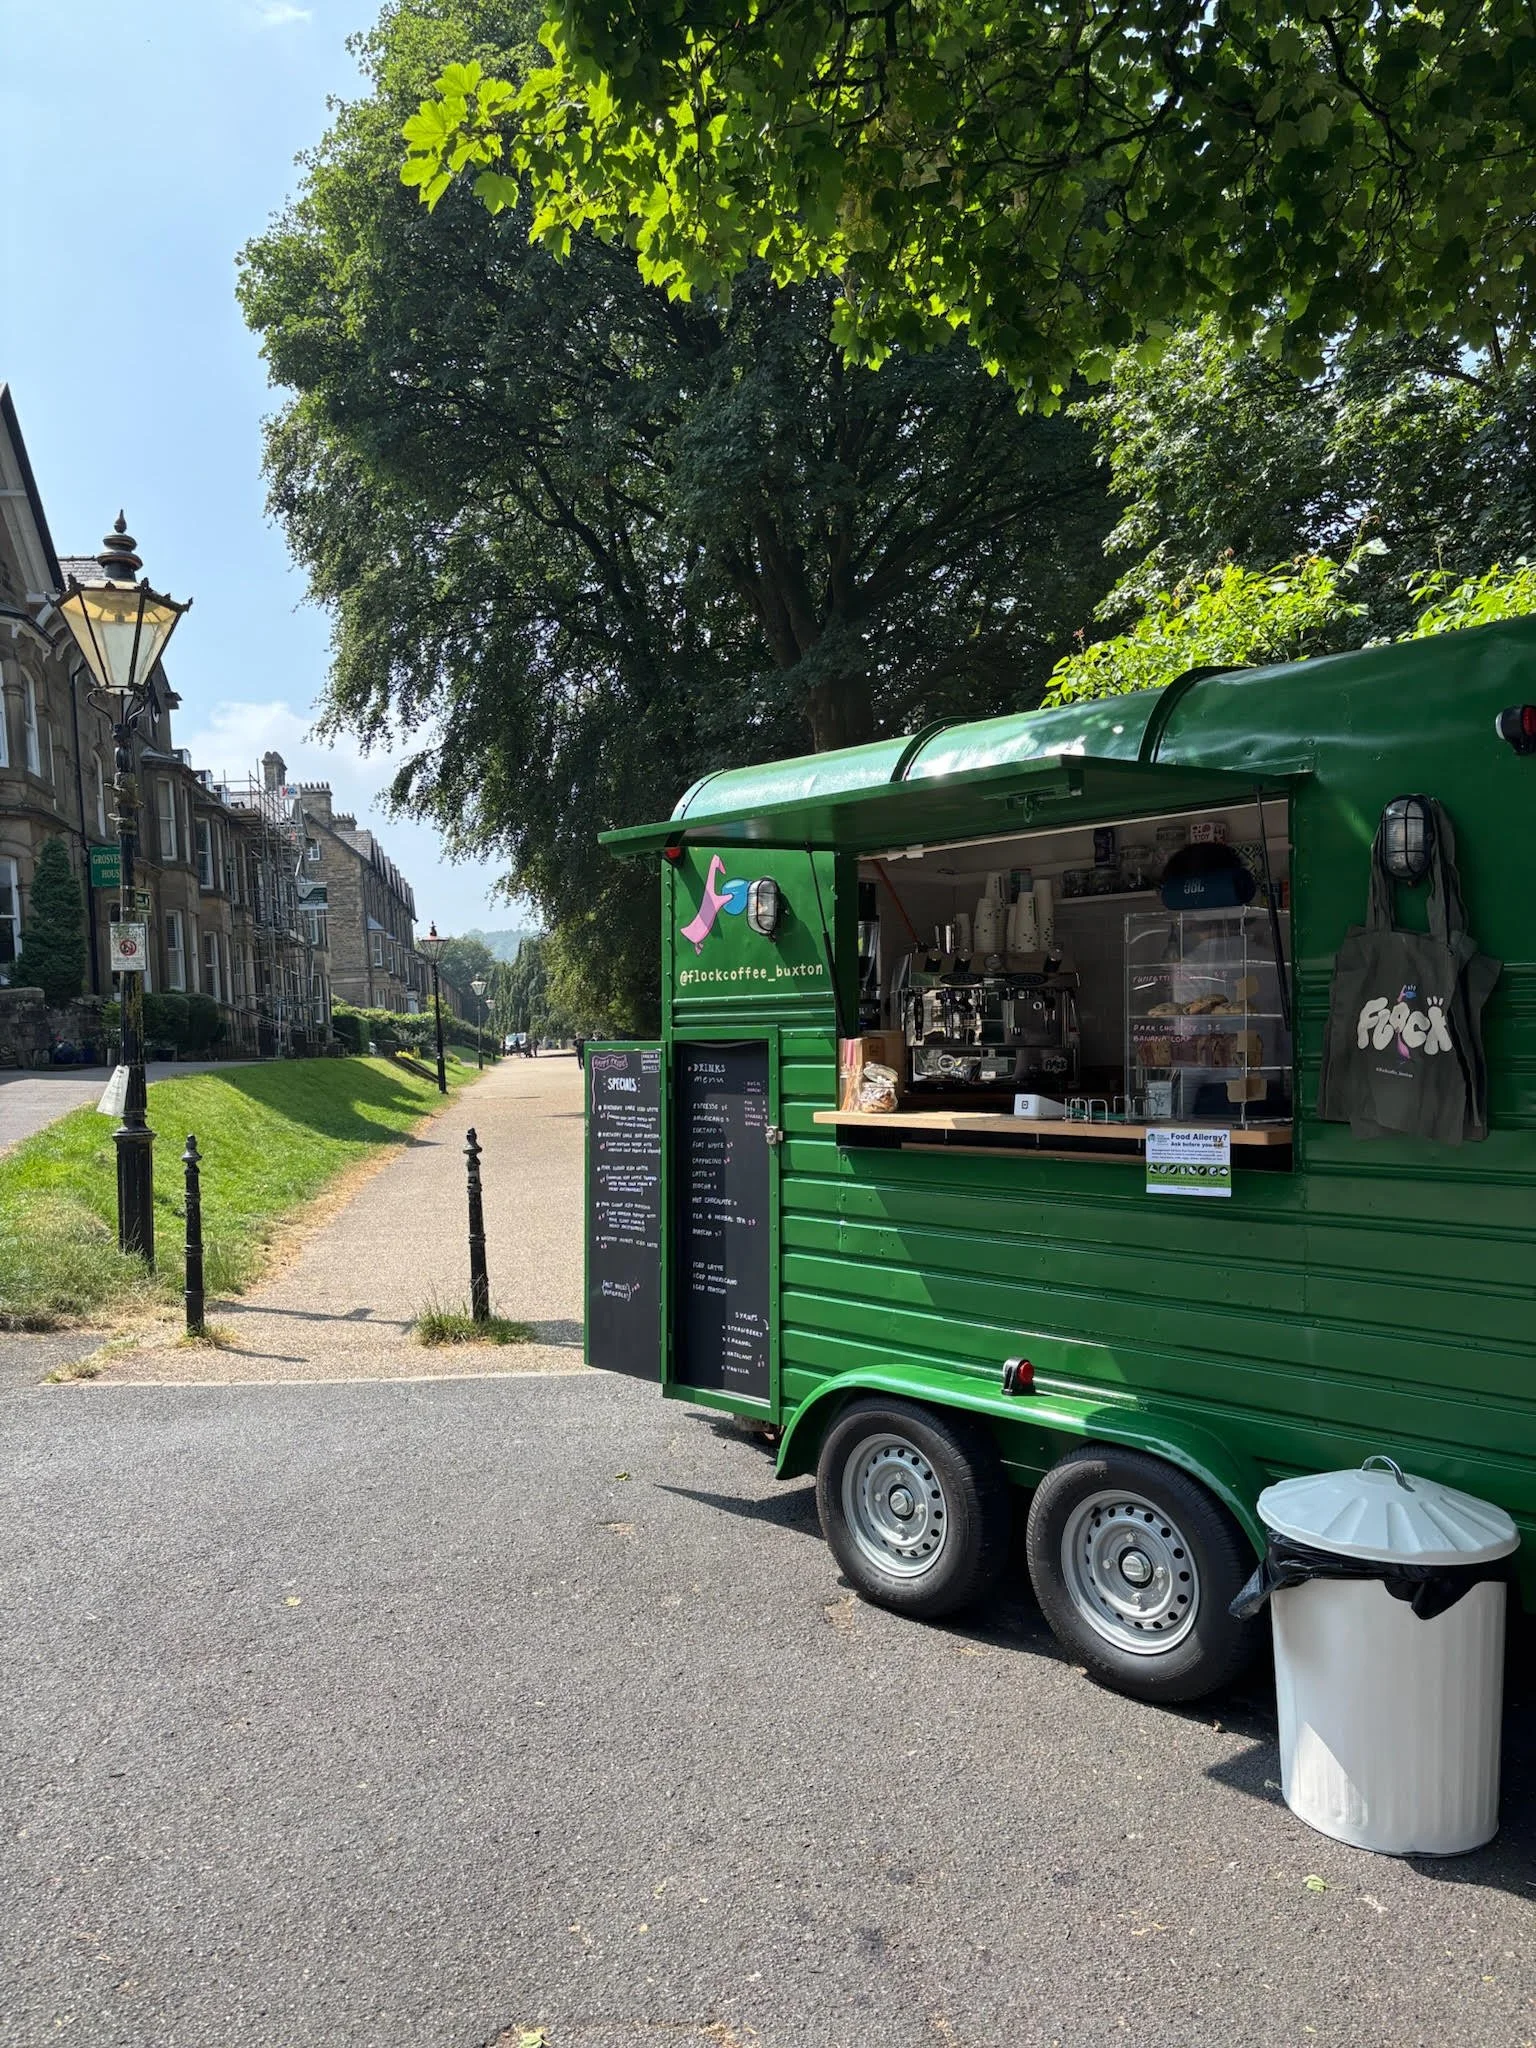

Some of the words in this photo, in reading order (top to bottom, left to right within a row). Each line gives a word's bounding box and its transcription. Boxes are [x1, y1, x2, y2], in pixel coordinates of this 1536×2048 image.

[679, 963, 823, 986] @flockcoffee_buxton
[1357, 996, 1453, 1056] FLOCK
[693, 1063, 726, 1073] DRINKS
[694, 1076, 724, 1084] menu
[1170, 1132, 1191, 1140] Food
[1193, 1133, 1227, 1143] Allergy?
[735, 1311, 758, 1321] SYRUPS
[727, 1324, 763, 1338] STRAWBERRY
[726, 1365, 750, 1375] VANILLA
